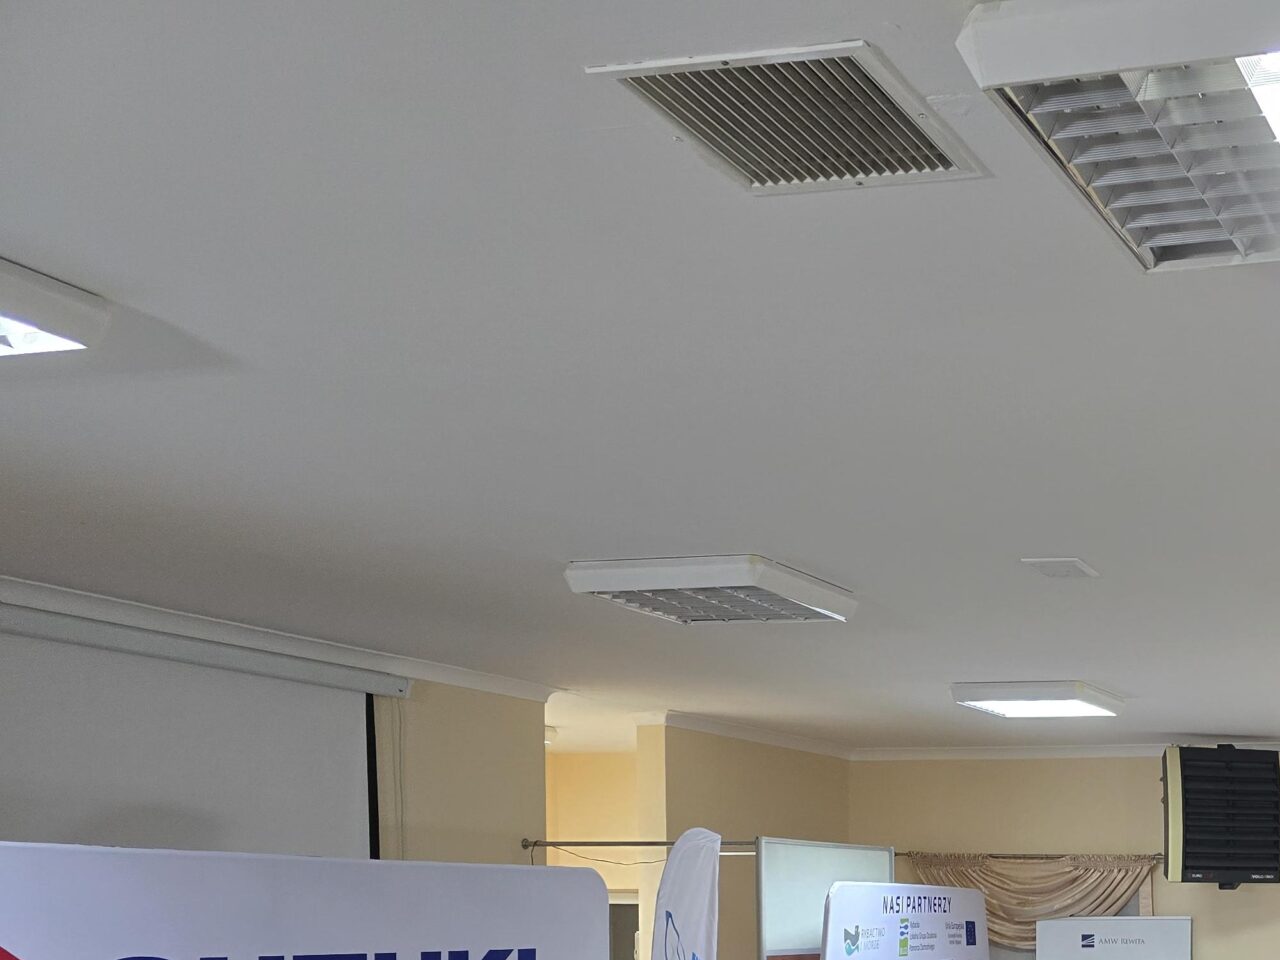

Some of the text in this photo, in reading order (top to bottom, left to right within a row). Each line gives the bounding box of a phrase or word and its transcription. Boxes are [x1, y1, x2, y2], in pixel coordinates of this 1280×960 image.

[882, 895, 952, 914] NASI PARTNERZY
[1098, 937, 1119, 945] AMW
